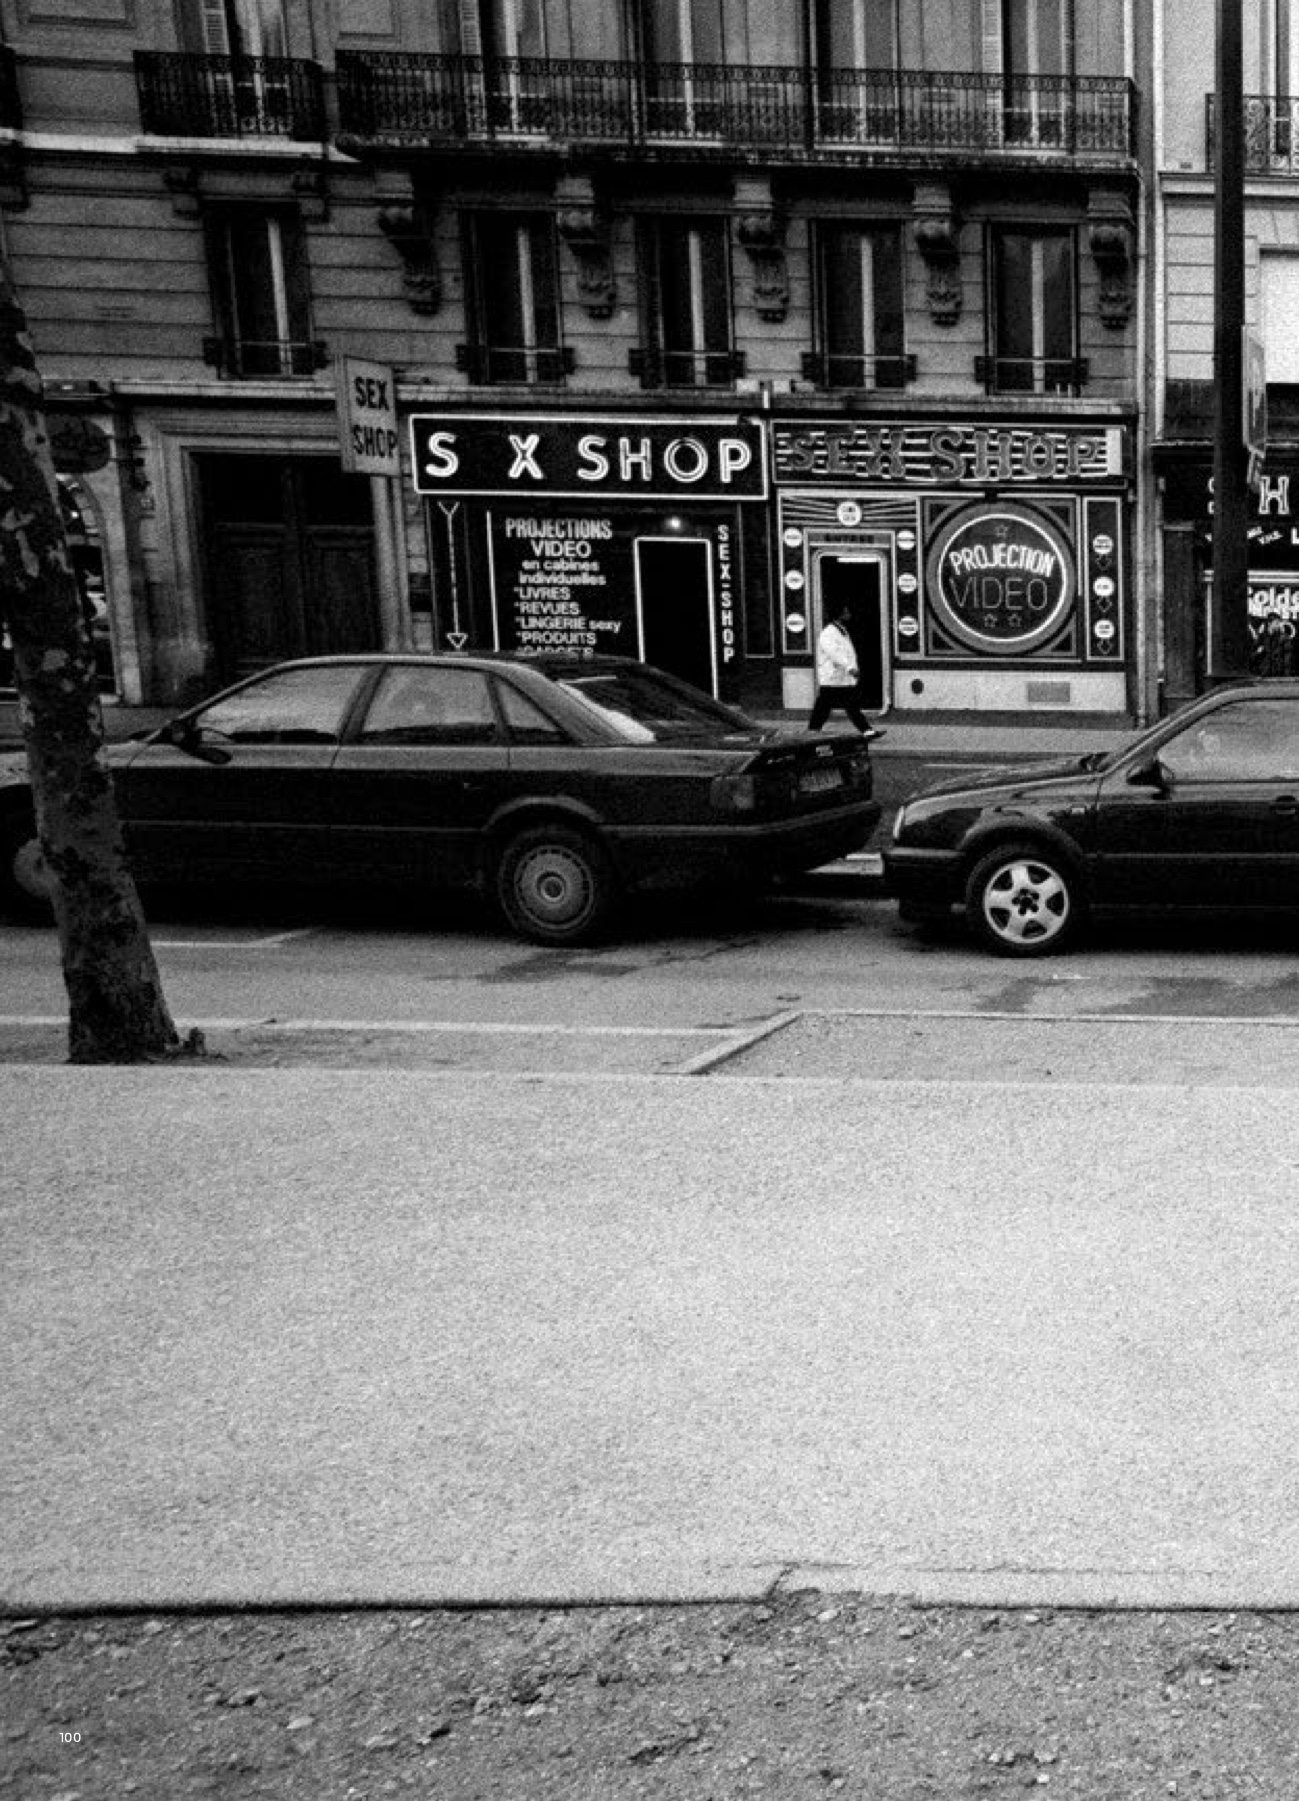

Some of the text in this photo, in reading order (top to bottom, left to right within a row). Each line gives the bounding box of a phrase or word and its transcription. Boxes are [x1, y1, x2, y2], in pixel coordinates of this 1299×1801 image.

[354, 377, 389, 411] SEX
[353, 425, 398, 458] SHOP
[788, 428, 1100, 481] SEX SHOP
[576, 434, 753, 484] SHOP
[506, 518, 613, 539] PROJECTIONS
[530, 540, 592, 558] VIDEO
[948, 543, 1056, 578] PROJECTION
[948, 576, 1048, 611] VIDEO
